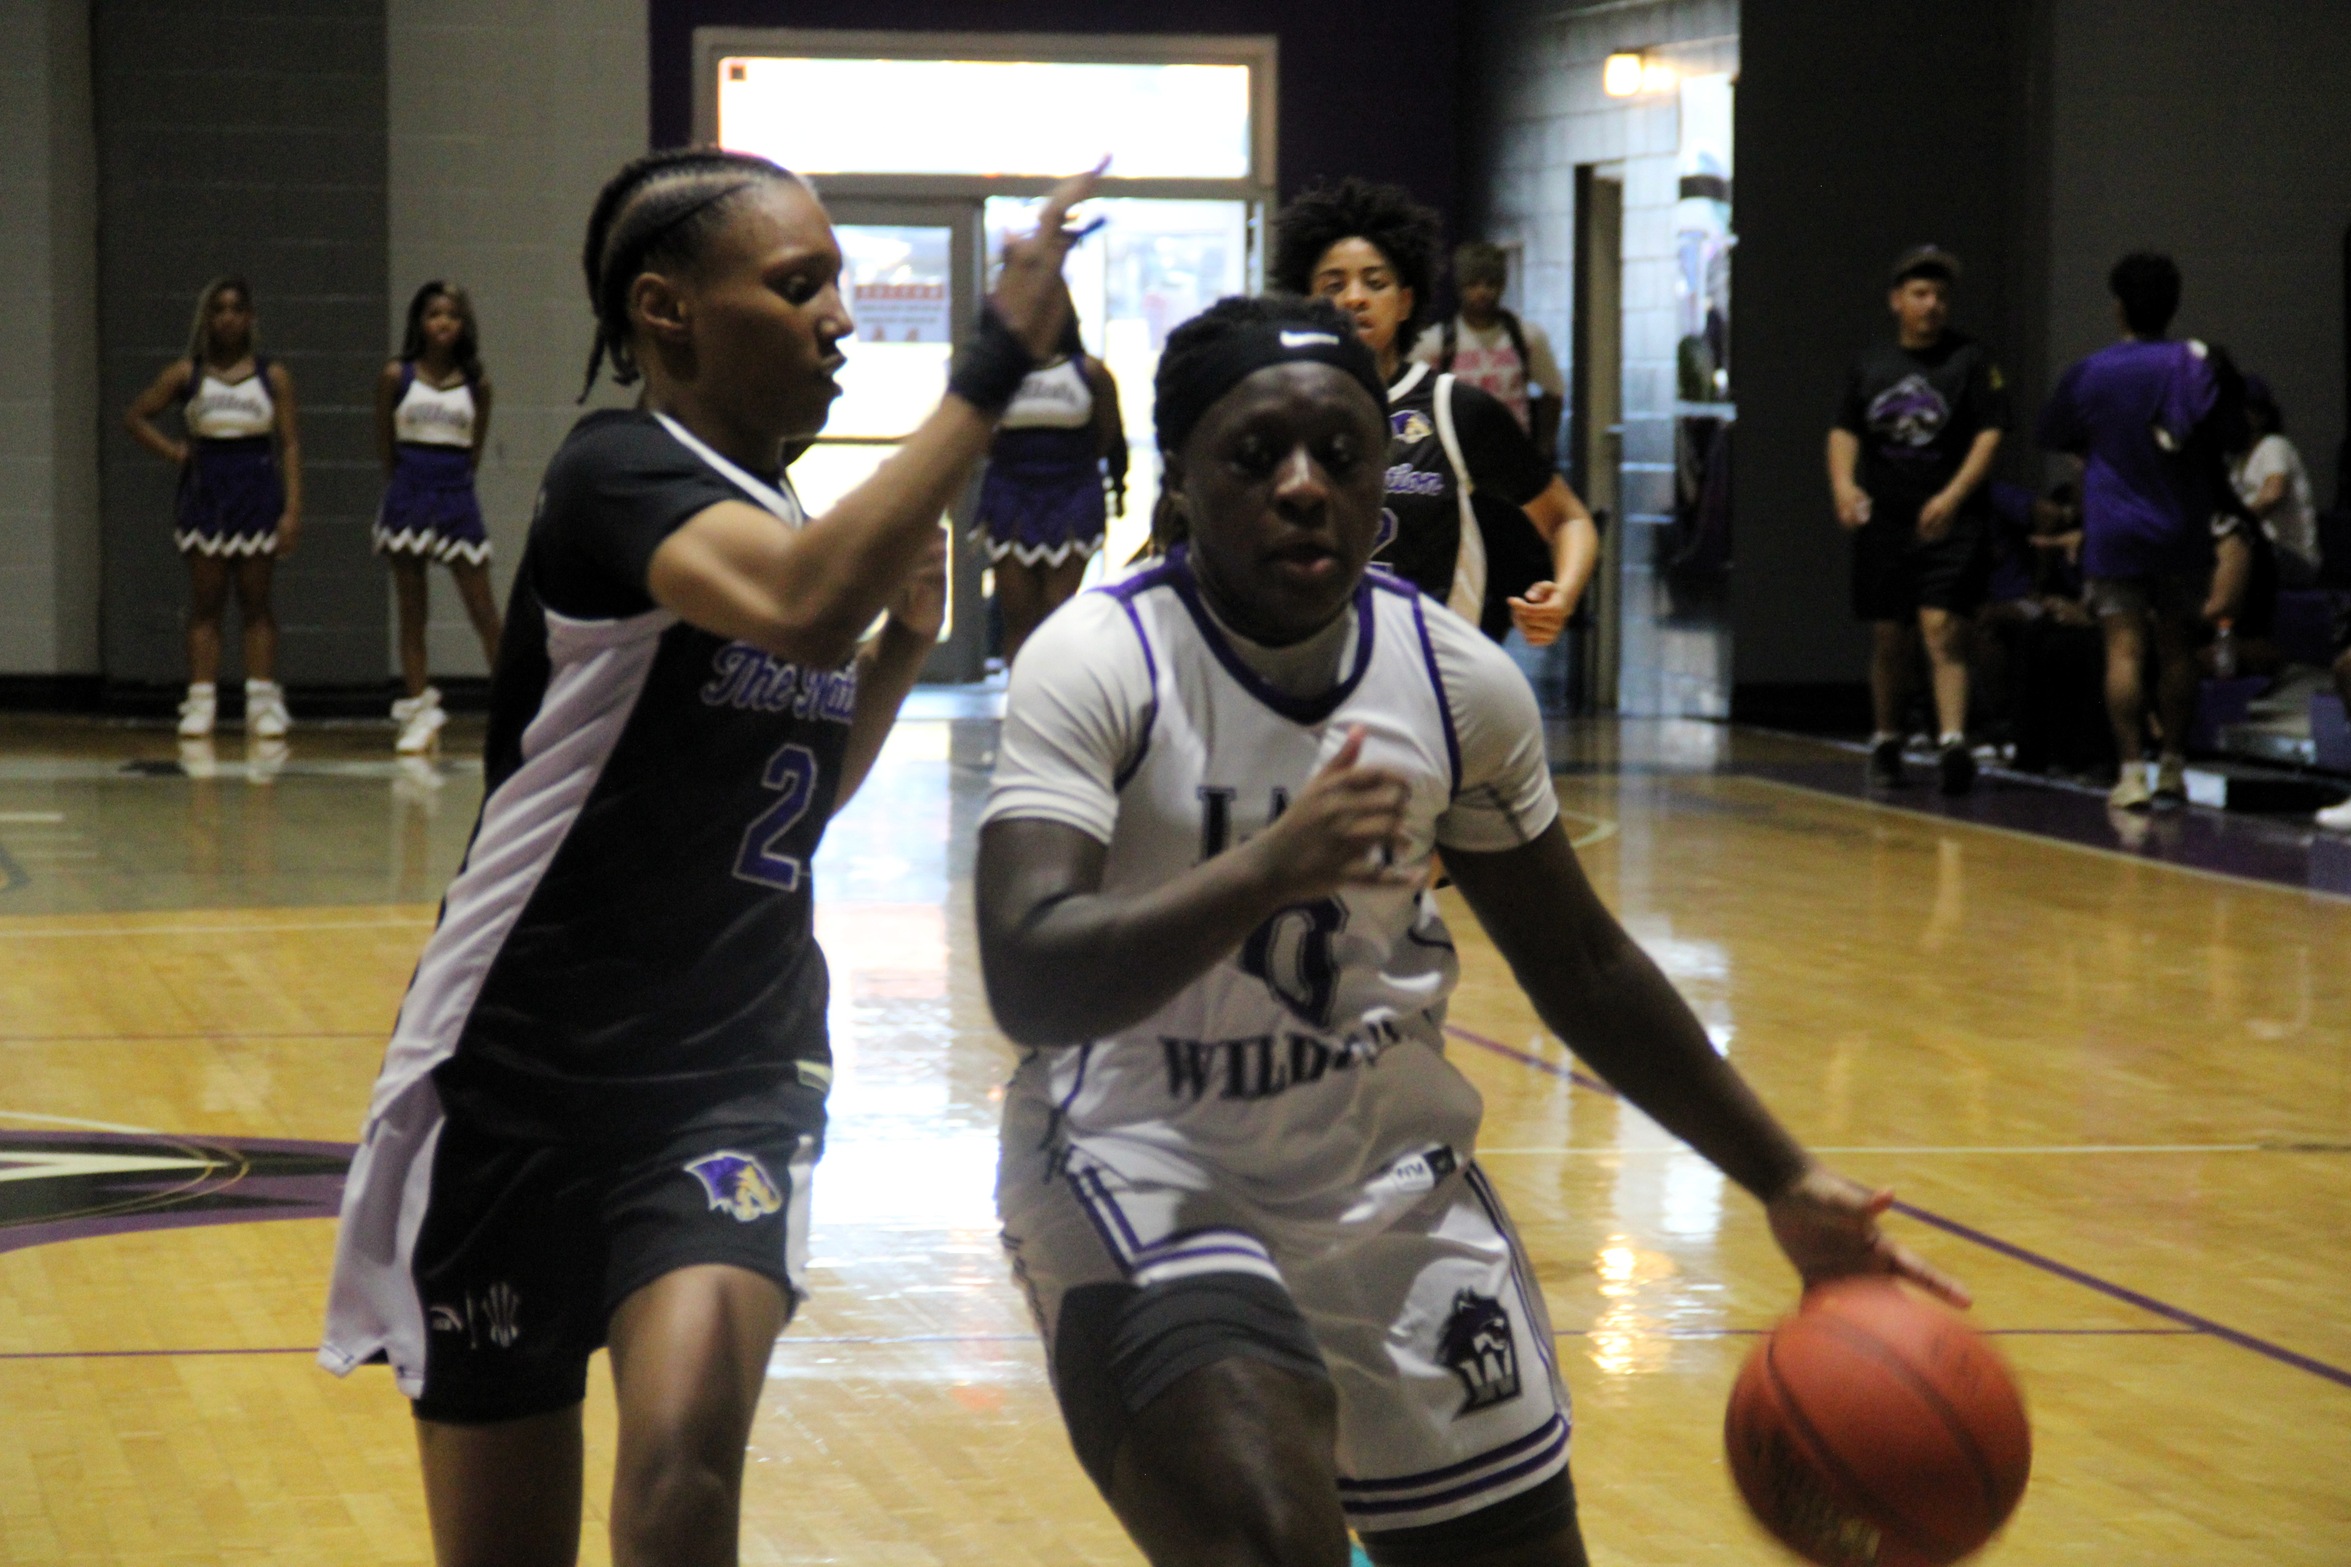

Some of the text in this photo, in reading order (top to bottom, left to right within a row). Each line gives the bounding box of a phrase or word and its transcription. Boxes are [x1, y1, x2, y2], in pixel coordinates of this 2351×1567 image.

[701, 640, 797, 711] The
[731, 742, 818, 893] 2
[1241, 894, 1350, 1033] 0
[1158, 1018, 1402, 1101] WILD
